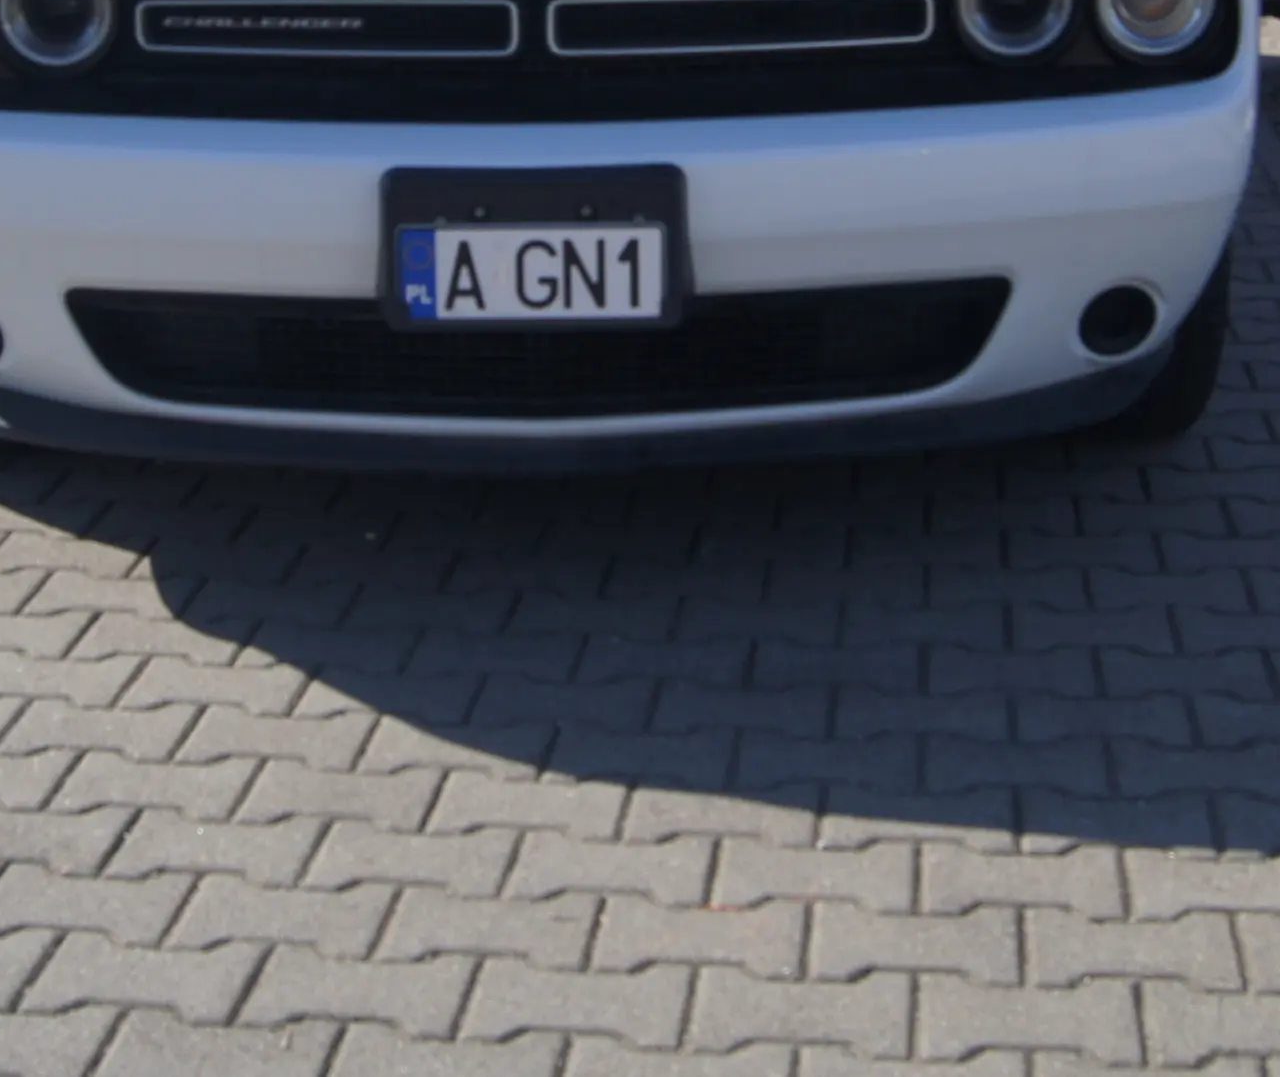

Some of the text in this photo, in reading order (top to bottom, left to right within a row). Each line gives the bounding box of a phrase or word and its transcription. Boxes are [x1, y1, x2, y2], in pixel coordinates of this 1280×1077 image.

[405, 238, 640, 310] PL A GN1
